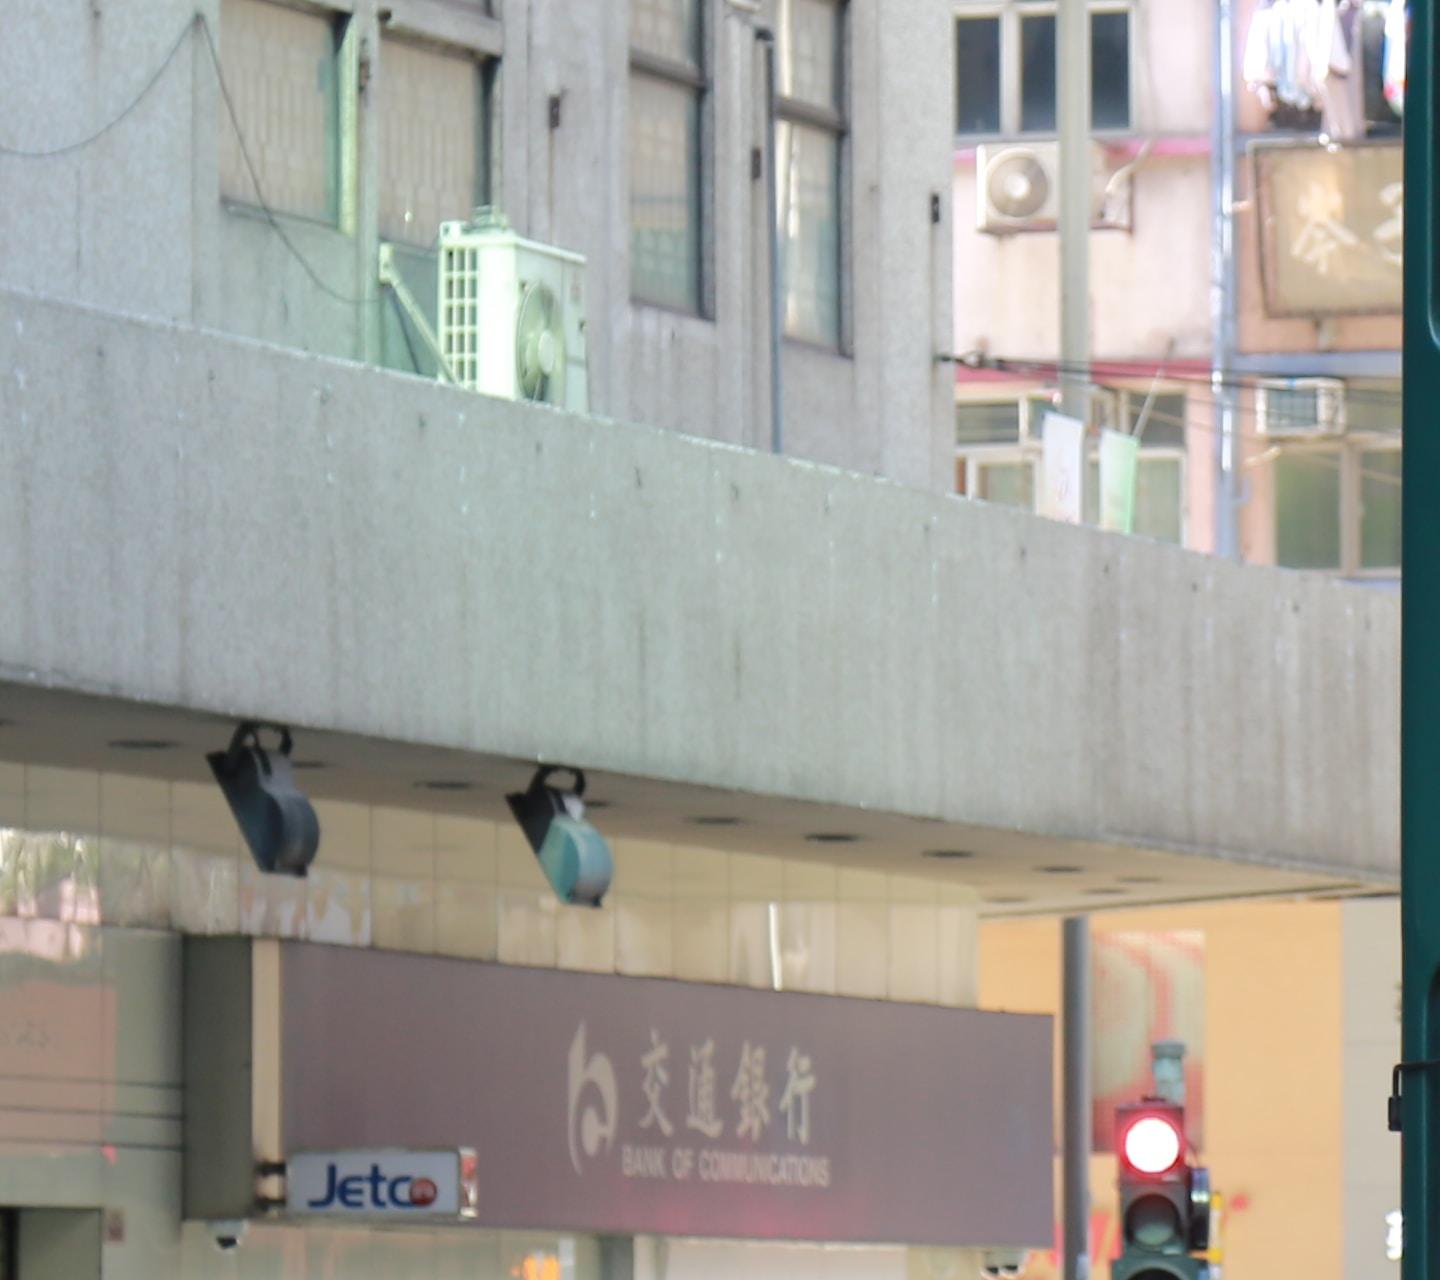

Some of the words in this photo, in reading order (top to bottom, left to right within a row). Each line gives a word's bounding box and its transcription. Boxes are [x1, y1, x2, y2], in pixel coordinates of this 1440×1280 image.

[637, 1028, 817, 1146] 交通銀行
[622, 1145, 665, 1177] BANK
[671, 1149, 695, 1181] OF
[698, 1151, 831, 1189] COMMUNICATIONS
